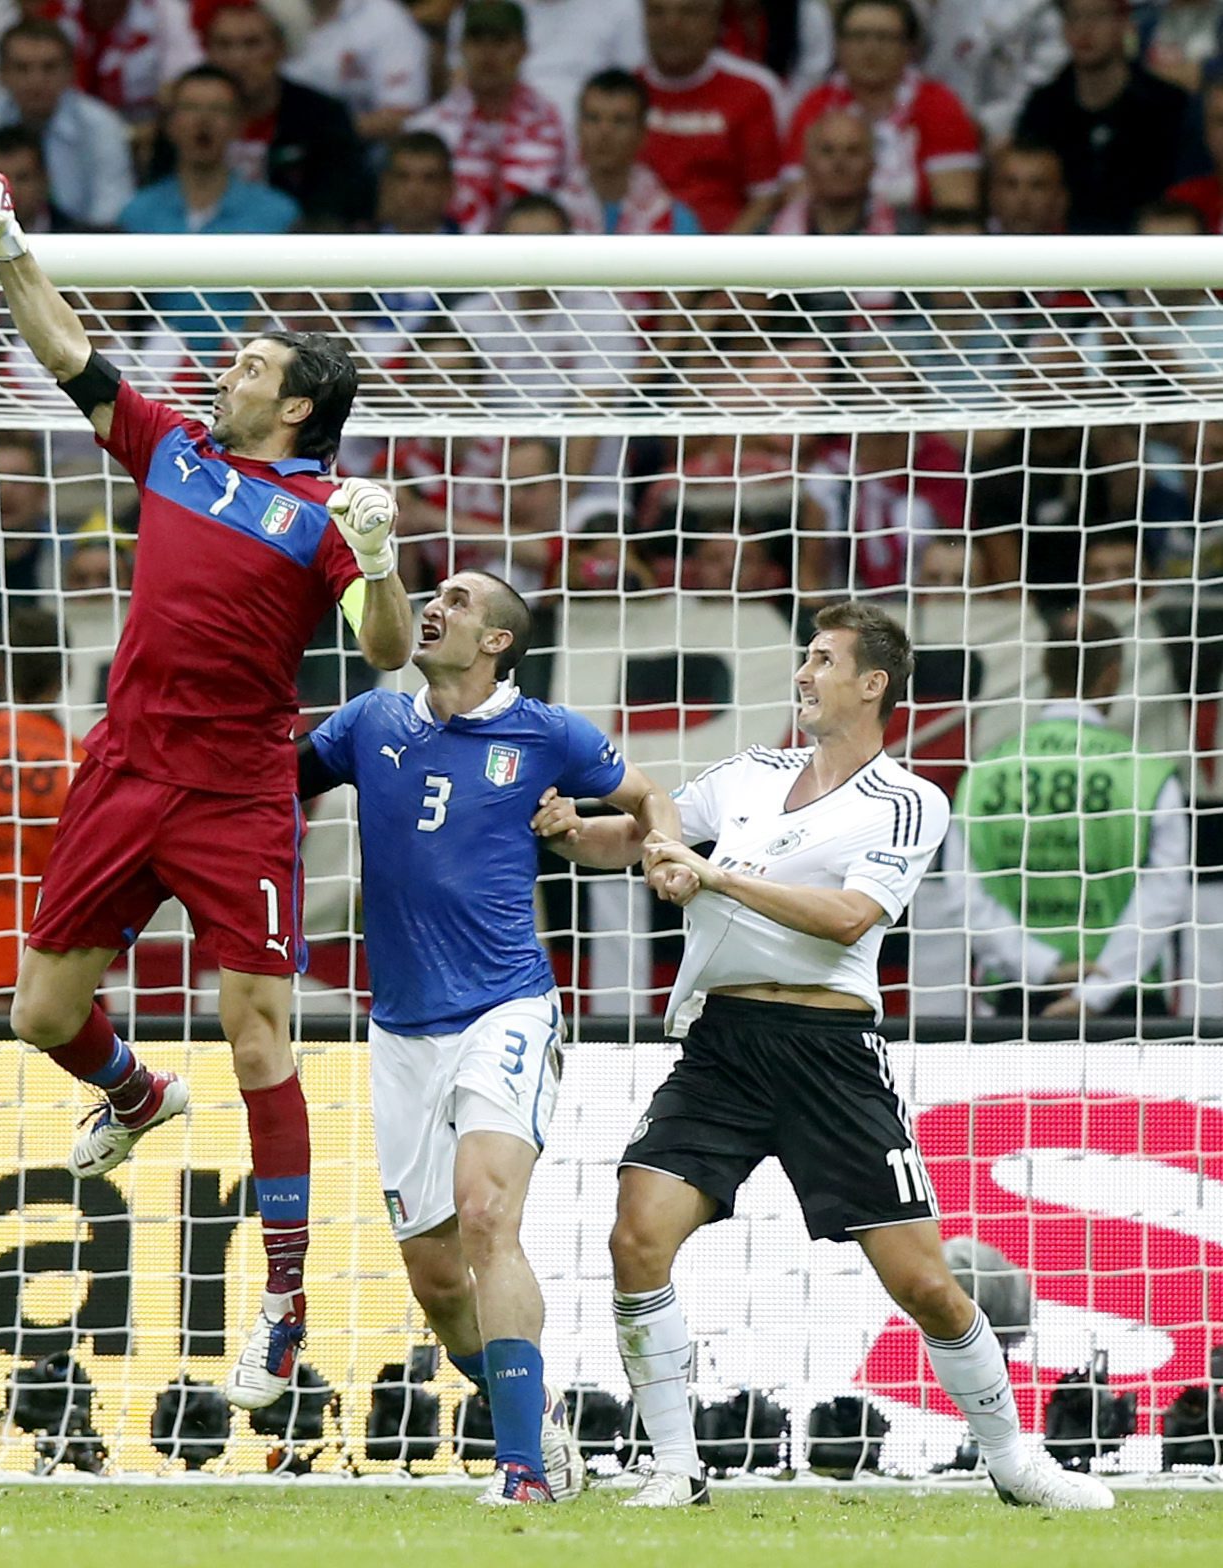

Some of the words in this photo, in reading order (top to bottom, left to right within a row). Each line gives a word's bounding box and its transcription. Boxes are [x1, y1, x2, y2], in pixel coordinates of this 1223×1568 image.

[209, 468, 241, 516] 1
[417, 775, 453, 832] 3
[260, 879, 279, 935] 1
[500, 1029, 527, 1075] 3
[262, 1193, 300, 1202] ITALIA
[886, 1148, 926, 1204] 11
[496, 1367, 528, 1379] ITALIA
[978, 1382, 1009, 1406] DF
